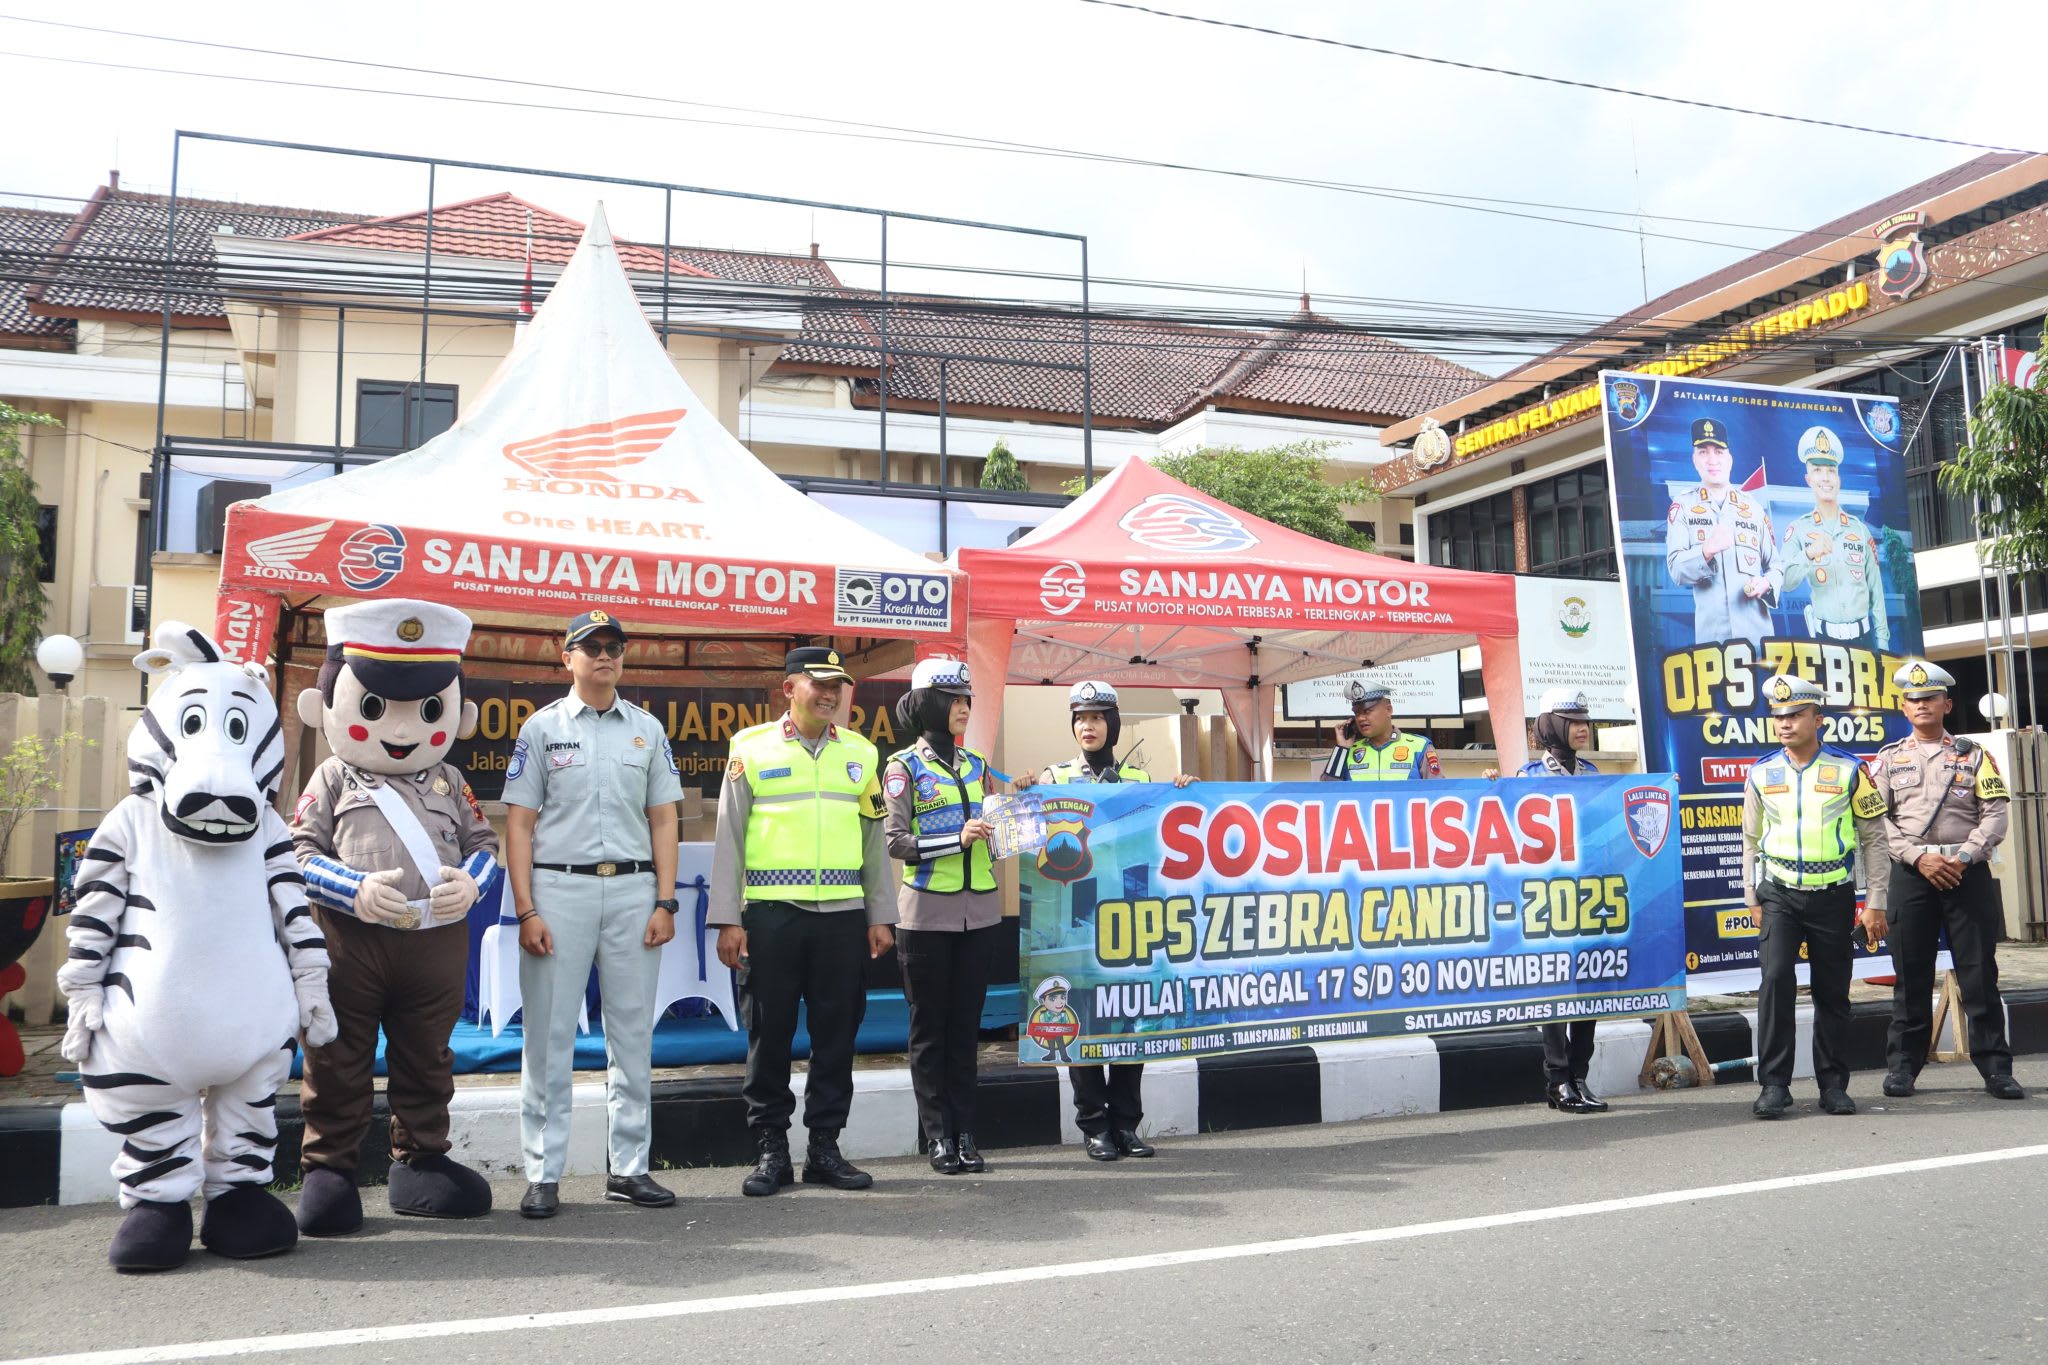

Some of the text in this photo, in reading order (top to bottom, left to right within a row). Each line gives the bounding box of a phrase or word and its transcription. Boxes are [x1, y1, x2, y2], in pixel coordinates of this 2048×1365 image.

[1891, 212, 1916, 225] TENGAH
[1455, 282, 1868, 457] SENTRA PELAYANA POLISIAN TERPADU
[1673, 391, 1844, 413] SATLANTAS POLRES BANJARNEGARA
[503, 477, 704, 503] HONDA
[502, 510, 711, 541] One HEART.
[1735, 521, 1758, 532] POLRI
[1843, 542, 1864, 553] POLRI
[243, 565, 330, 584] HONDA
[421, 538, 818, 604] SANJAYA MOTOR
[453, 581, 492, 592] PUSAT
[493, 585, 534, 597] MOTOR
[537, 589, 577, 601] HONDA
[580, 592, 638, 605] TERBESAR
[648, 597, 720, 611] TERLENGKAP
[728, 603, 788, 615] TERMURAH
[883, 577, 946, 604] OTO
[1119, 568, 1430, 607] SANJAYA MOTOR
[884, 602, 943, 616] Kredit Motor
[1094, 600, 1133, 613] PUSAT
[1136, 602, 1184, 615] MOTOR
[1187, 604, 1233, 617] HONDA
[1237, 605, 1293, 618] TERBESAR
[1304, 608, 1376, 621] TERLENGKAP
[1387, 611, 1454, 624] TERPERCAYA
[837, 615, 848, 623] by
[862, 616, 893, 625] SUMMIT
[914, 619, 948, 628] FINANCE
[1662, 642, 1904, 713] OPS ZEBRA
[1702, 716, 1886, 744] CAN 2025
[545, 742, 580, 752] AFRIYAN
[1710, 764, 1736, 777] TMT
[916, 799, 946, 813] DHIANIS
[1042, 800, 1090, 813] AWA TENGAH
[1627, 791, 1667, 802] LALU LINTAS
[1680, 805, 1744, 829] 10 SASARA
[1161, 798, 1575, 880] SOSIALISASI
[1717, 832, 1744, 842] KENDARAA
[1096, 896, 1196, 964] OPS
[1202, 890, 1352, 956] ZEBRA
[1359, 883, 1488, 945] CANDI
[1522, 877, 1627, 936] 2025
[1700, 953, 1720, 964] Satuan
[1721, 951, 1734, 961] Lalu
[1735, 949, 1753, 960] Lintas
[1096, 949, 1628, 1018] MULAI TANGGAL 17 S/D 30 NOVEMBER 2025
[1405, 994, 1669, 1031] SATLANTAS POLRES BANJARNEGARA
[1082, 1042, 1137, 1058] PREDIKTIF
[1144, 1035, 1225, 1055] RESPONSIBILITAS
[1232, 1026, 1301, 1046] TRANSPARANSI
[1308, 1020, 1368, 1038] BERKEADILAN
